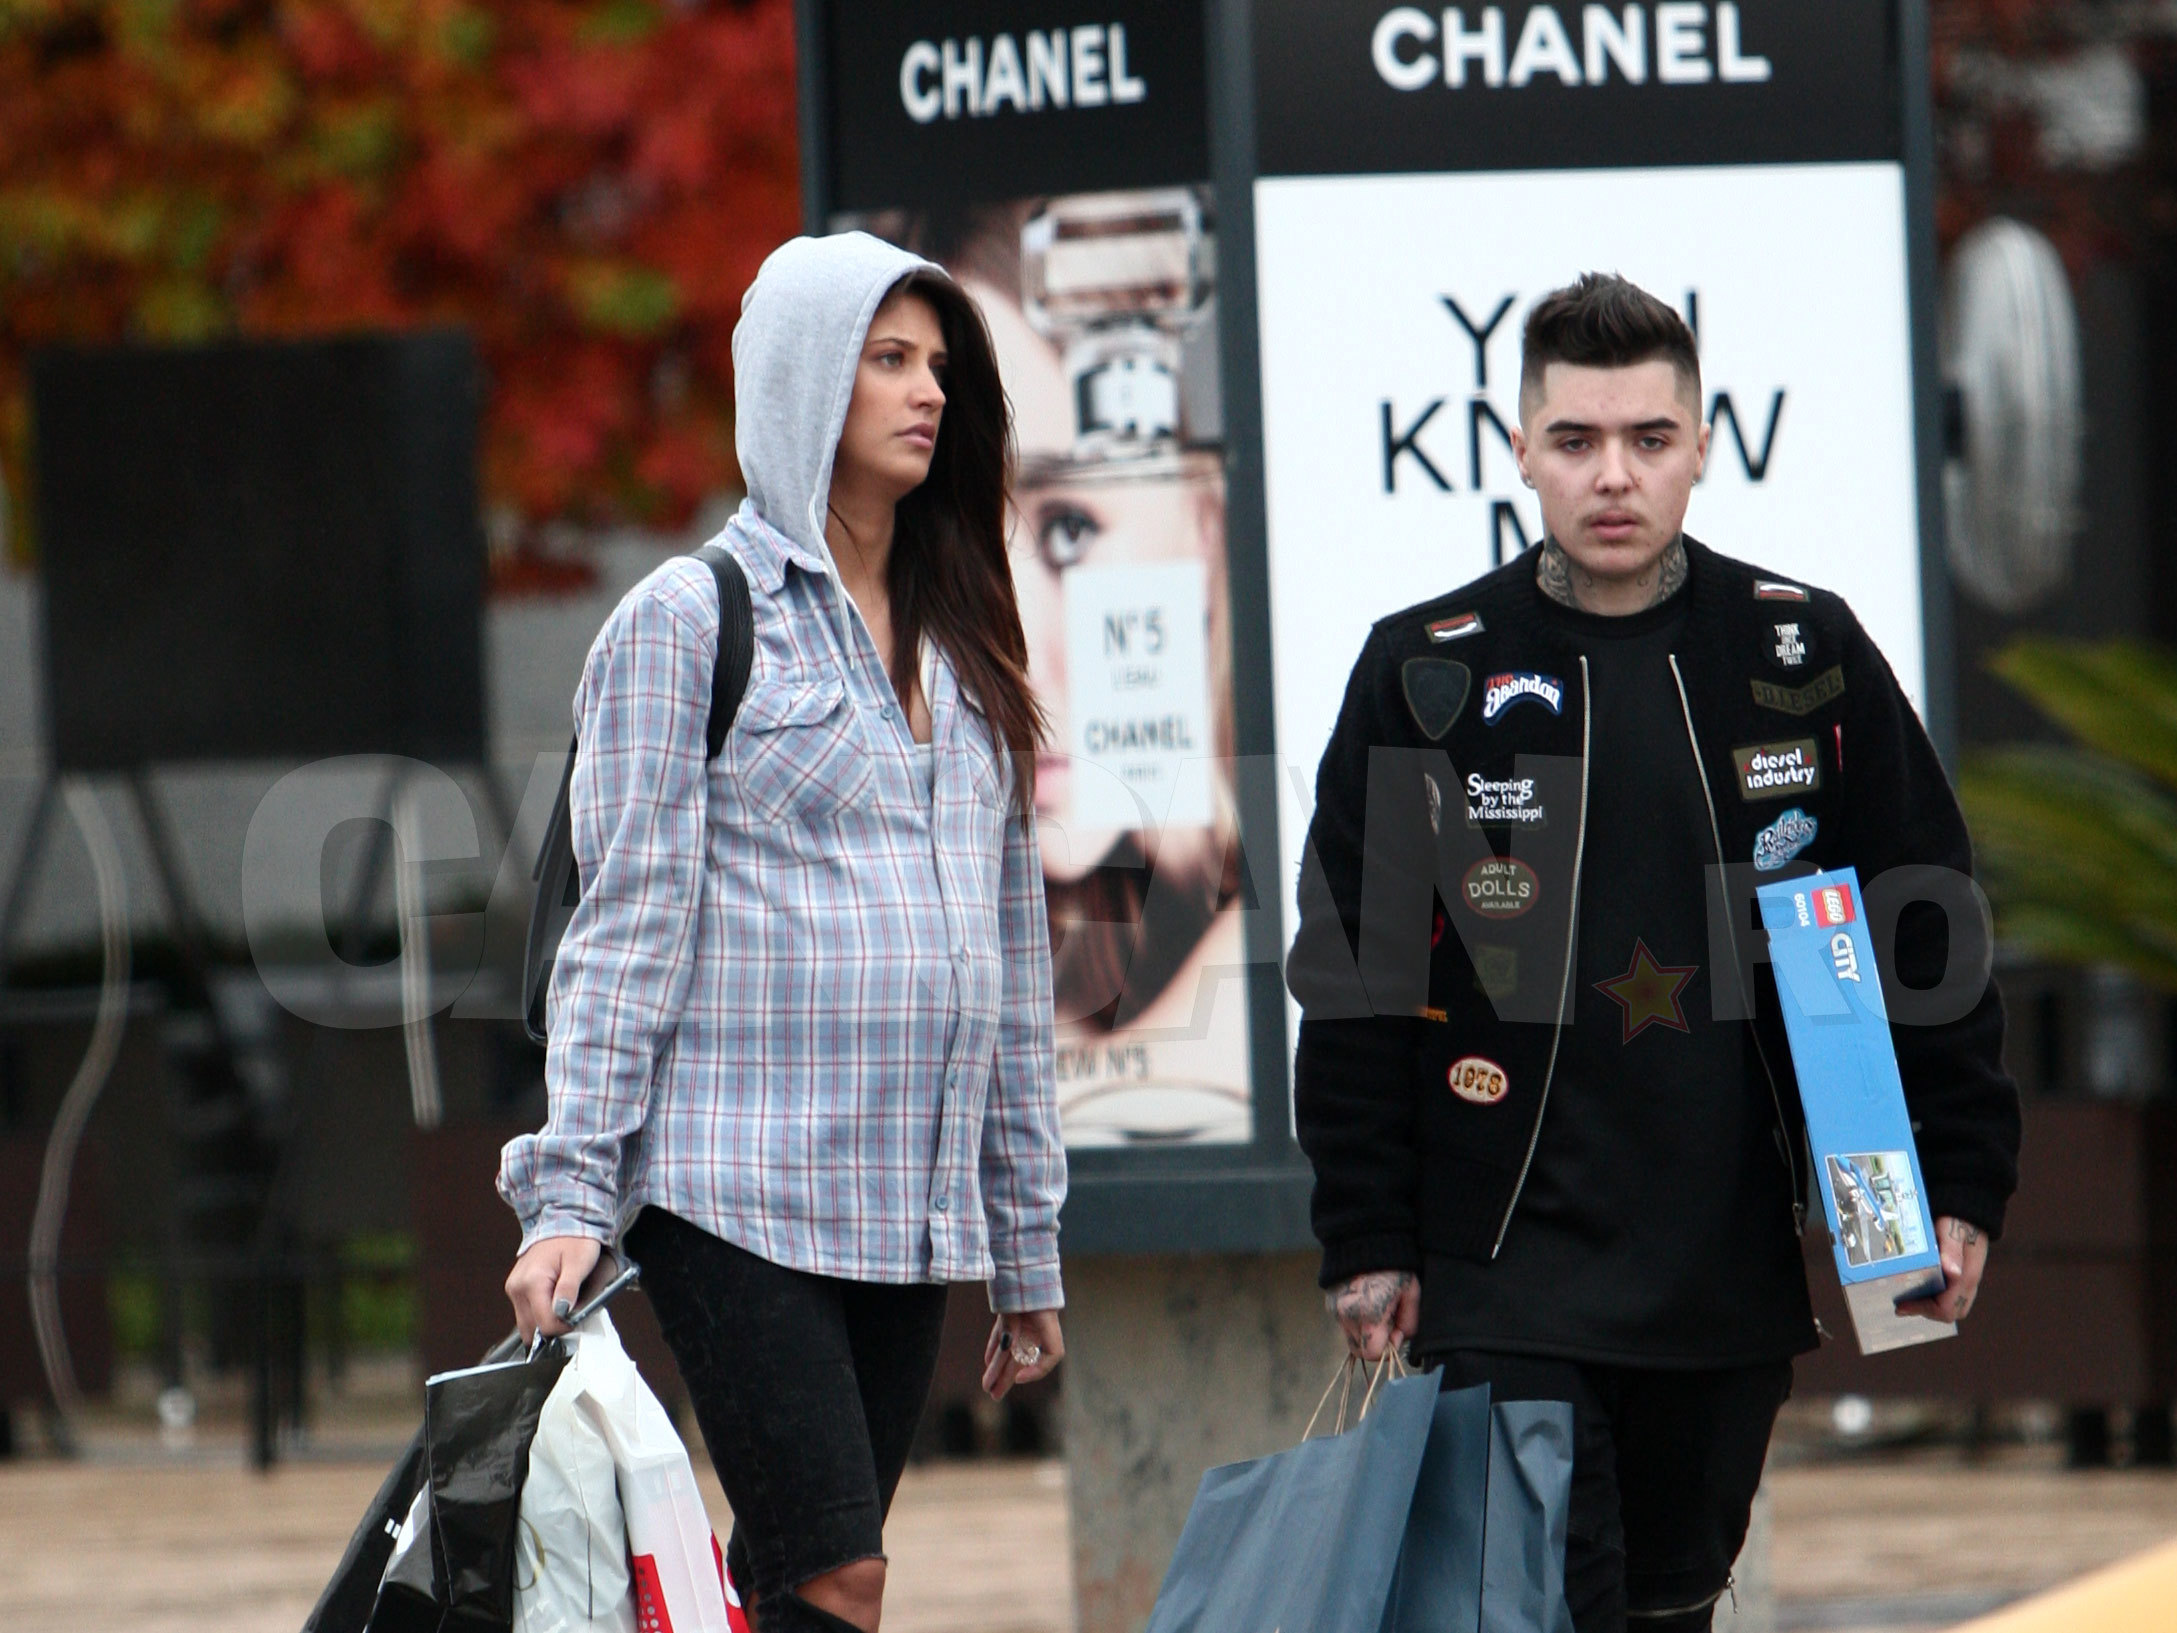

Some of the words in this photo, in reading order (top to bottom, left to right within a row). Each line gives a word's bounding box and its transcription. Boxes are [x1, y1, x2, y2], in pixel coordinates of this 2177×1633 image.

[1371, 1, 1771, 90] CHANEL
[900, 22, 1147, 123] CHANEL
[1380, 389, 1785, 492] KNW
[1775, 642, 1805, 658] DREAM
[1085, 716, 1194, 753] CHANEL
[1751, 748, 1803, 771] diesel
[1467, 773, 1533, 800] Sleeping
[1746, 766, 1815, 789] industry
[1468, 805, 1542, 822] Mississippi
[1481, 794, 1499, 808] by
[1501, 793, 1525, 806] the
[1481, 863, 1517, 876] ADULT
[1468, 880, 1530, 898] DOLLS
[1794, 893, 1811, 928] 60104
[1823, 888, 1847, 924] LEGO
[1830, 932, 1861, 983] CITY
